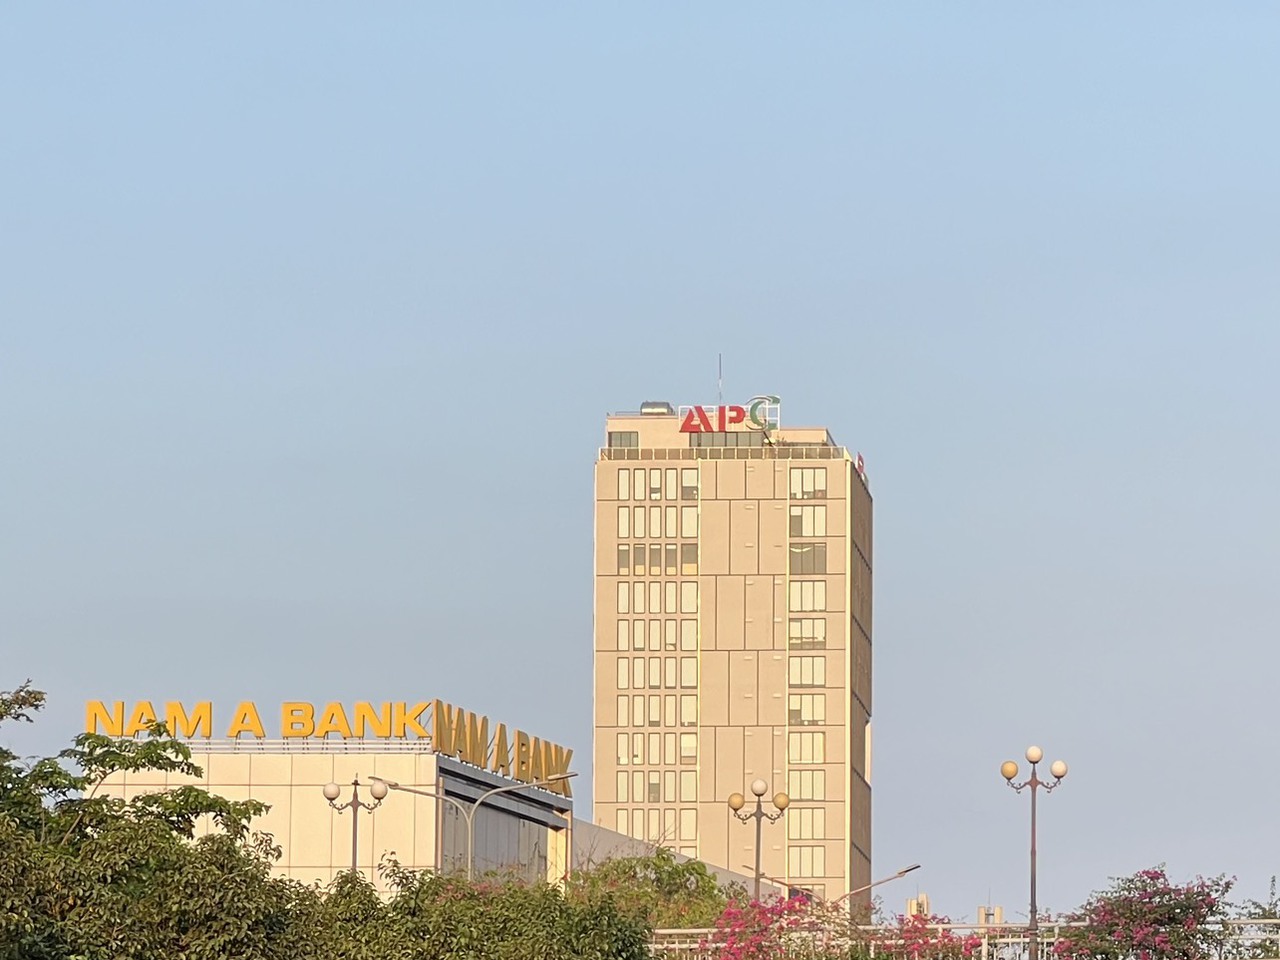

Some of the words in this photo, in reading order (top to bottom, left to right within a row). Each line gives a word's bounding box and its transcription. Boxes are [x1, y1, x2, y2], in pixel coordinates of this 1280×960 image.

[680, 395, 780, 432] APC
[86, 700, 212, 738] NAM
[226, 701, 266, 738] A
[281, 701, 432, 738] BANK
[432, 699, 488, 770] NAM
[491, 722, 511, 776] A
[513, 729, 574, 798] BANK
